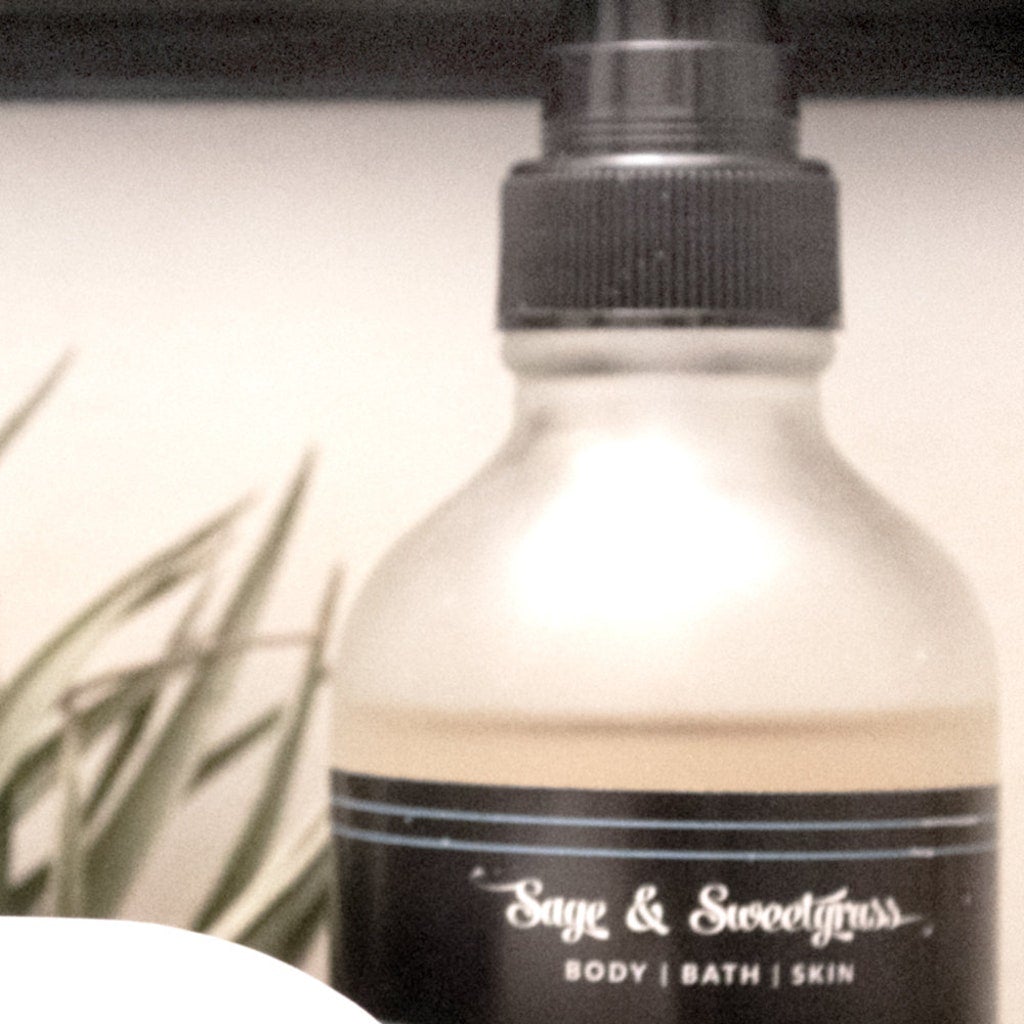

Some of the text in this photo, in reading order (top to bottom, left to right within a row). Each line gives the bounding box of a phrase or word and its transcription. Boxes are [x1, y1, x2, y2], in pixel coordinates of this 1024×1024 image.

[471, 867, 934, 948] Sage & Sweetgrass
[564, 960, 647, 984] BODY
[681, 963, 760, 985] BATH
[791, 964, 854, 985] SKIN
